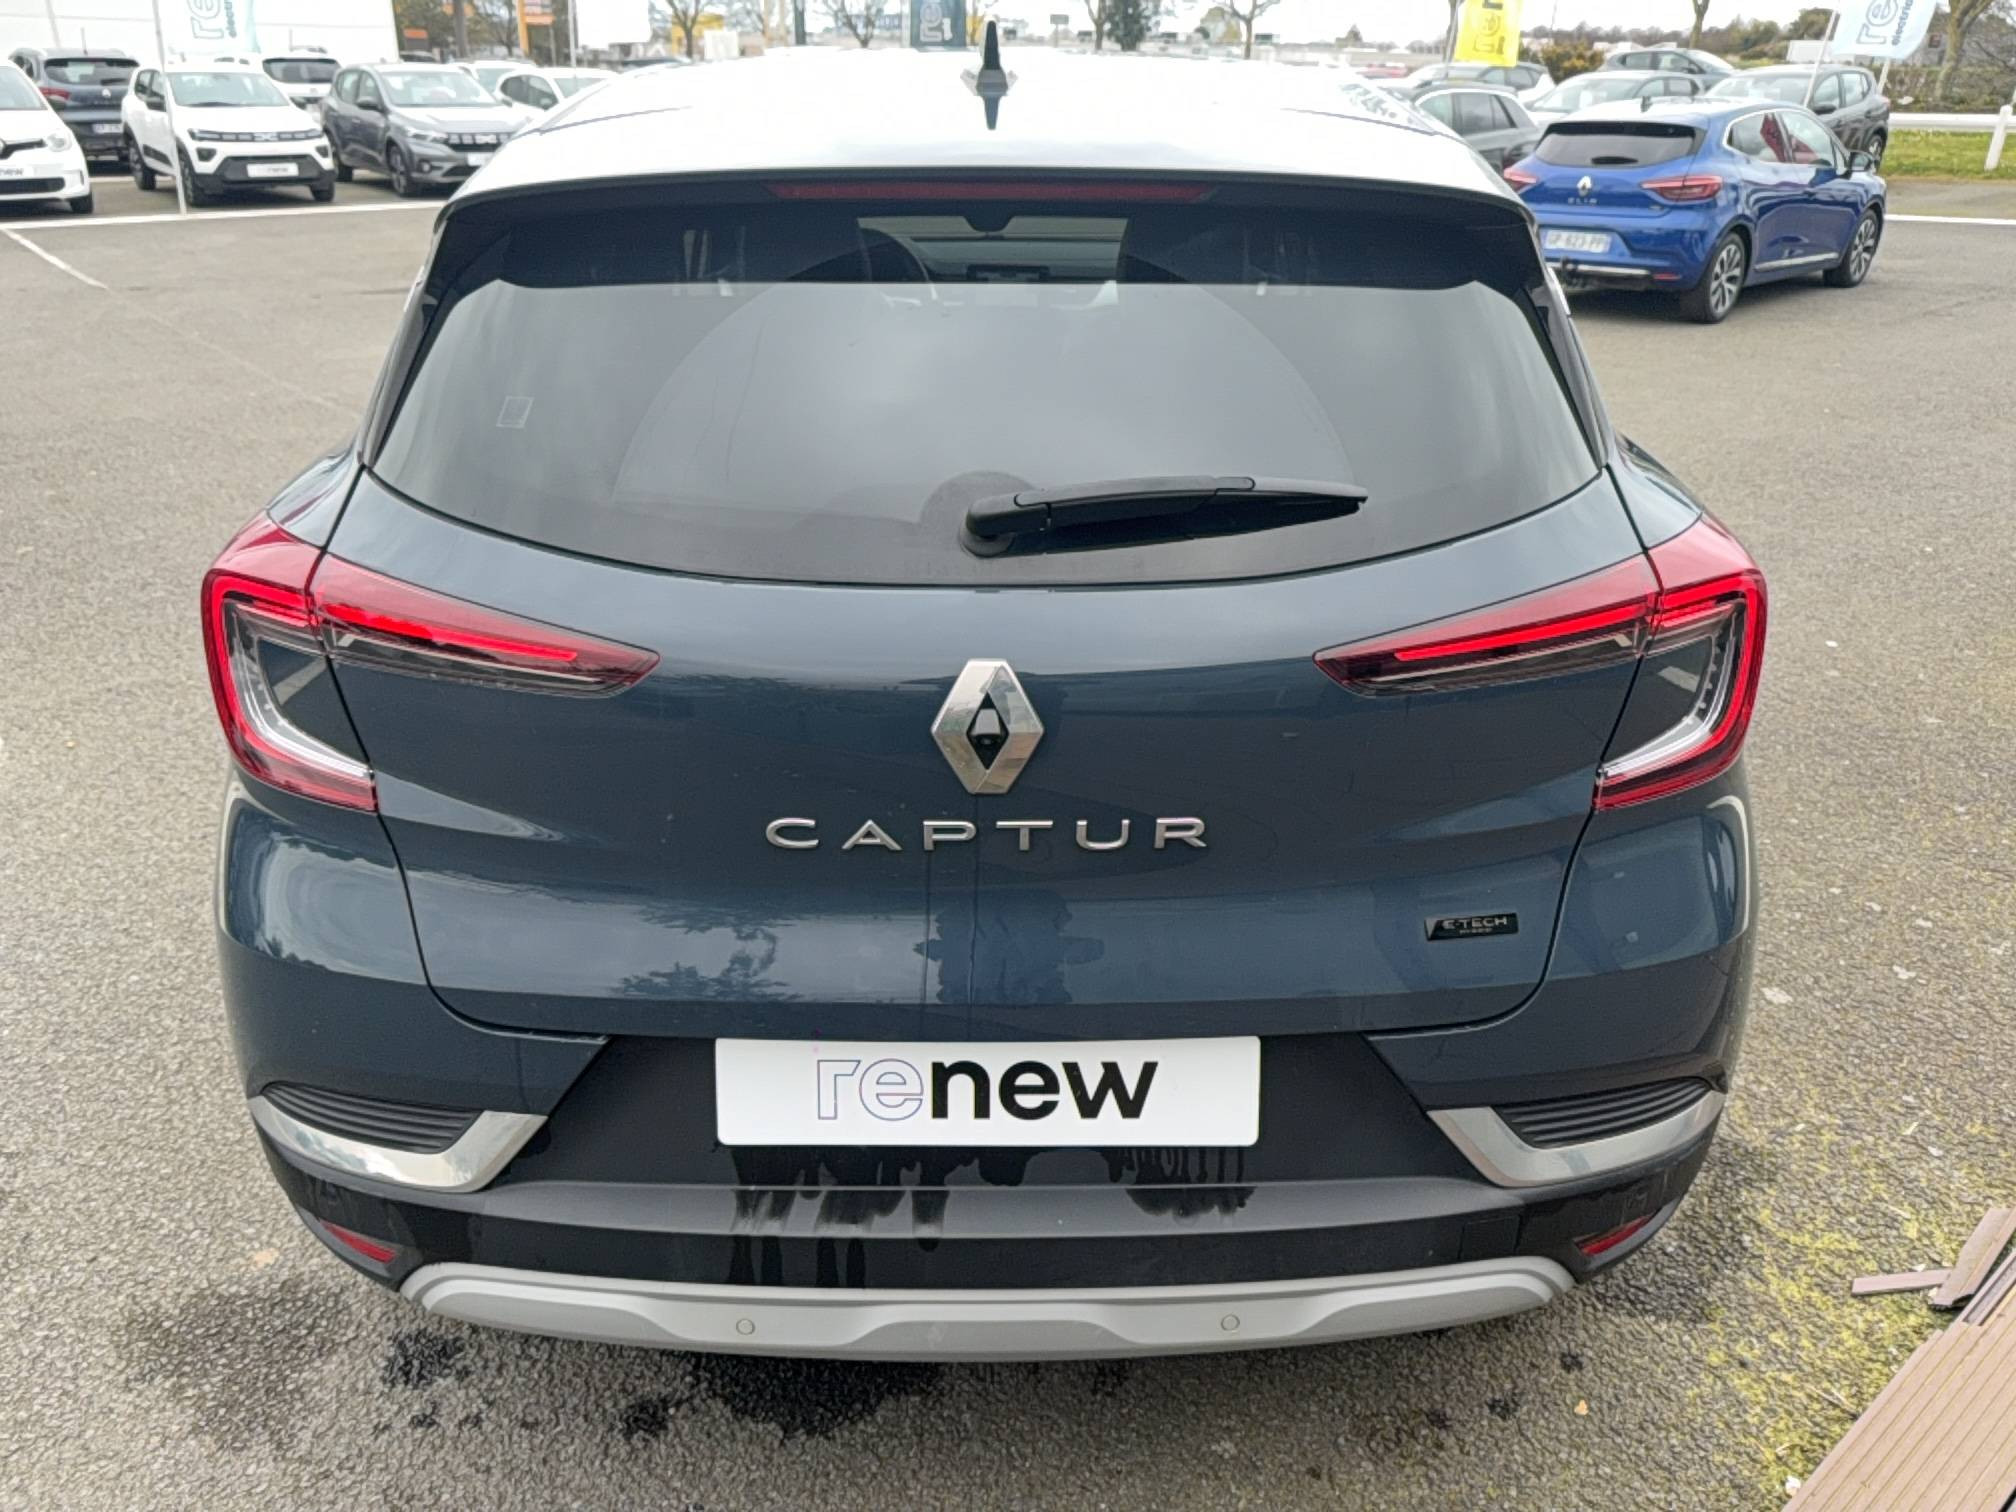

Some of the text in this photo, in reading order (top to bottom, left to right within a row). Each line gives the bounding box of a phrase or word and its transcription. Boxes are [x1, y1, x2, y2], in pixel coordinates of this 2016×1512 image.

[765, 817, 1206, 851] CAPTUR
[1442, 916, 1508, 929] E-TECH
[816, 1058, 1159, 1121] renew
